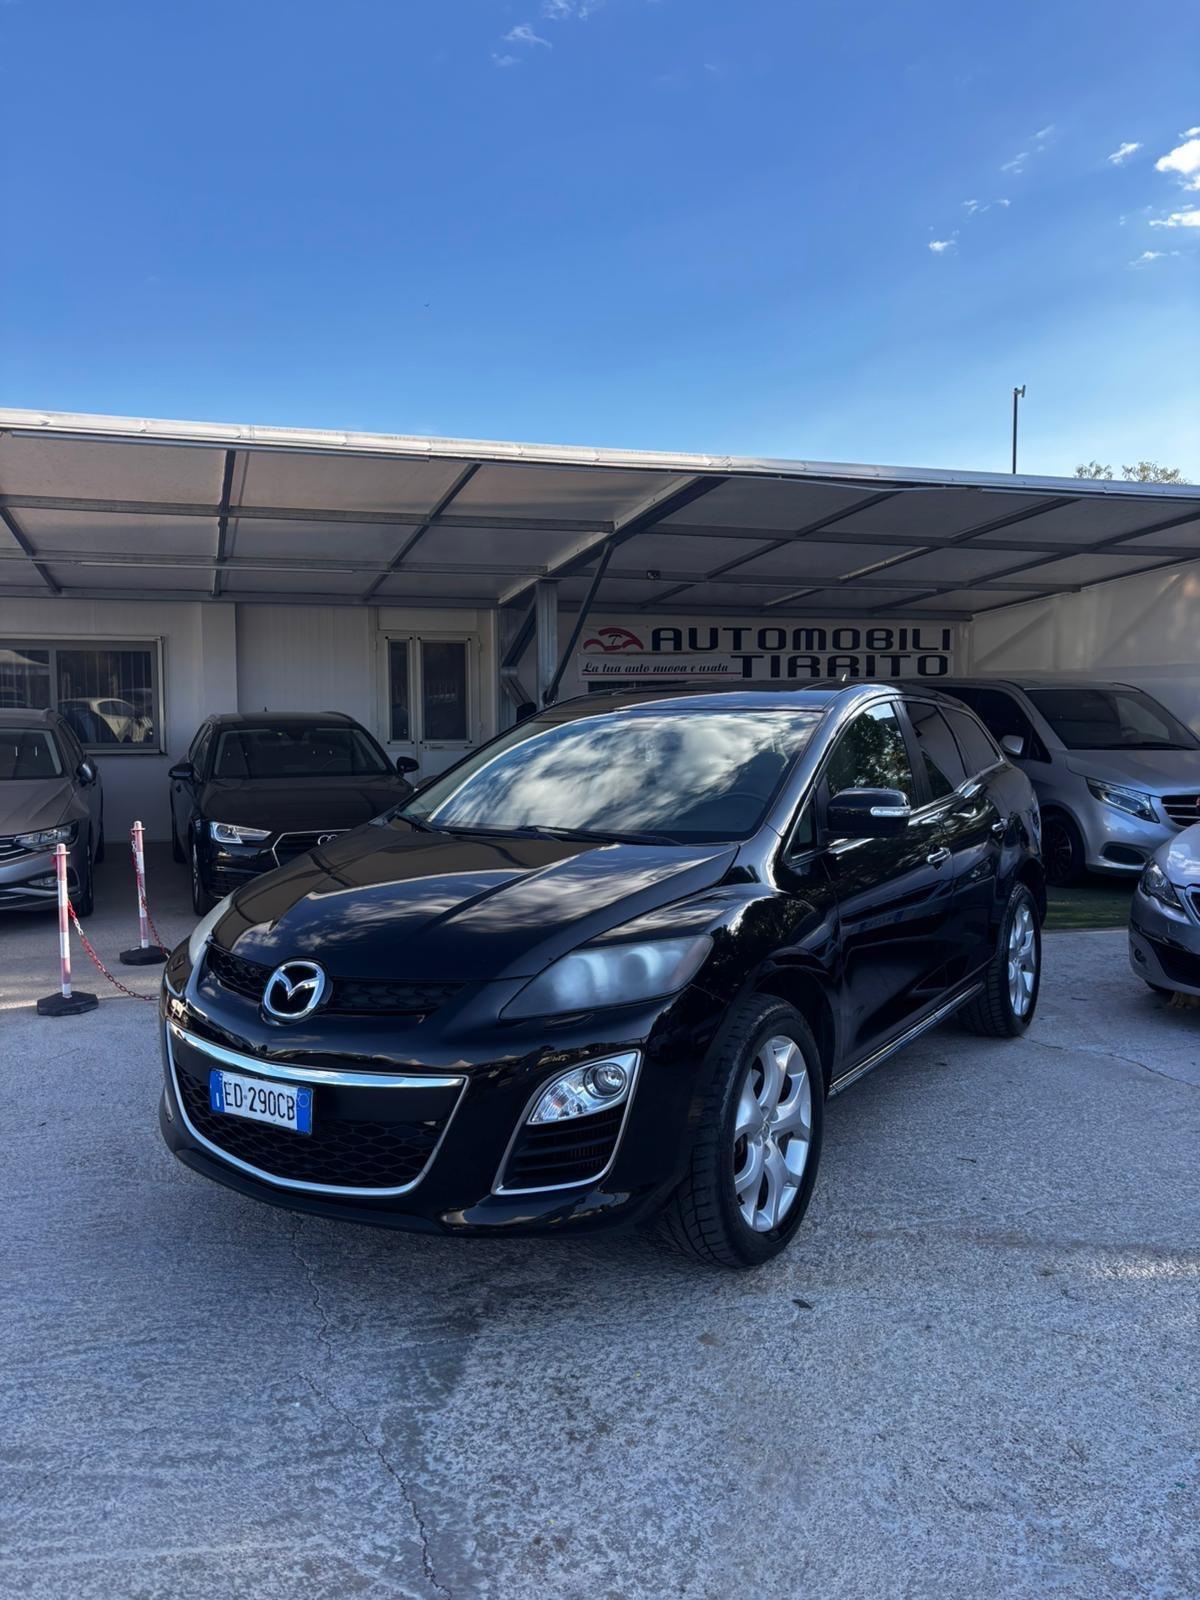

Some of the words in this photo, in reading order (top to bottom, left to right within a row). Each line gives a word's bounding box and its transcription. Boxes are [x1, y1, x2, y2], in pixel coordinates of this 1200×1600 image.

[652, 627, 951, 651] AUTOMOBILI
[582, 662, 600, 673] La
[602, 663, 621, 673] tua
[624, 663, 650, 673] auto
[653, 664, 687, 673] nuova
[690, 664, 697, 673] e
[698, 663, 729, 673] usata
[730, 654, 948, 678] TIRRITO
